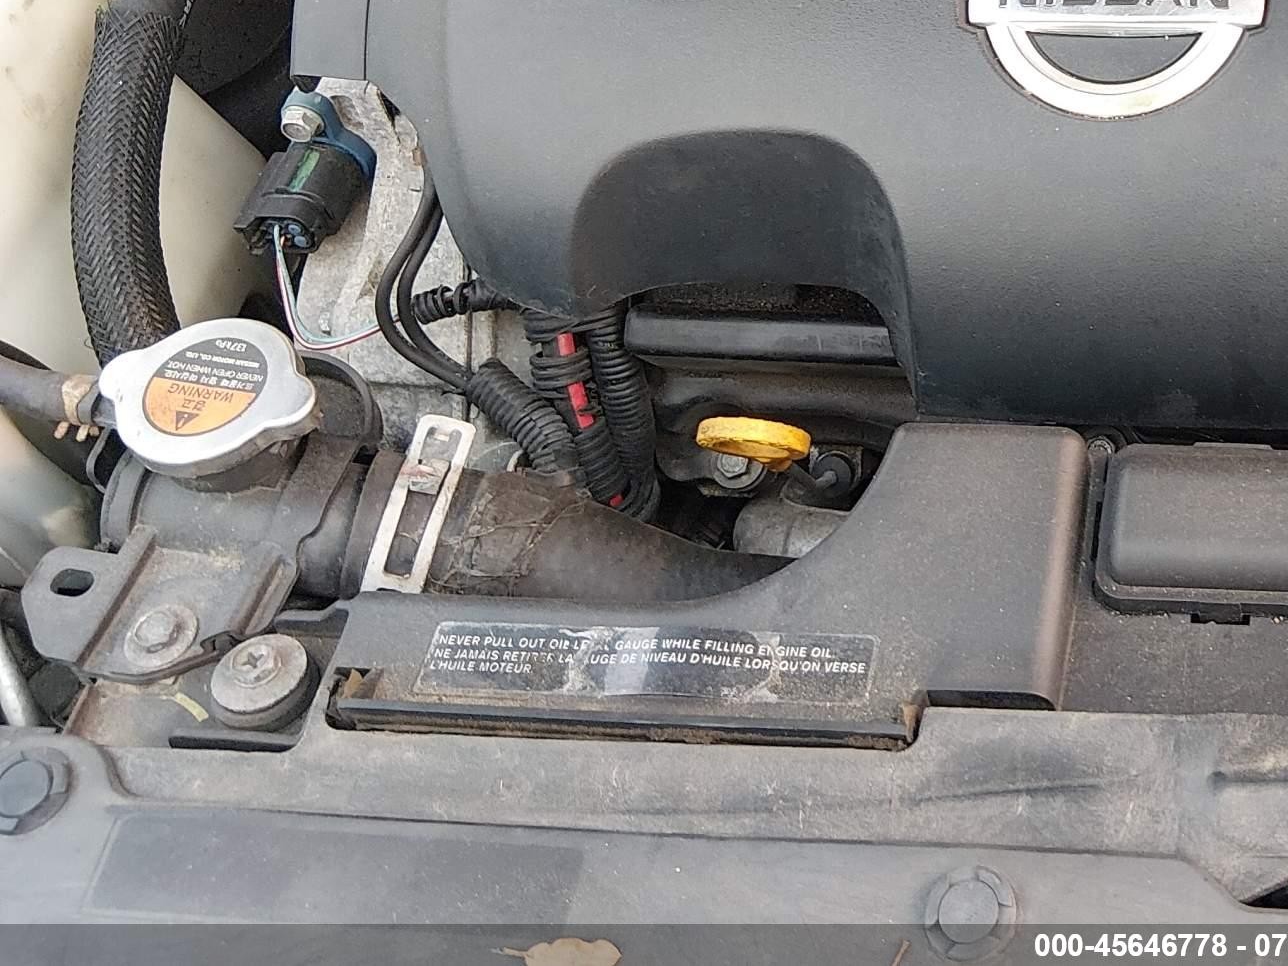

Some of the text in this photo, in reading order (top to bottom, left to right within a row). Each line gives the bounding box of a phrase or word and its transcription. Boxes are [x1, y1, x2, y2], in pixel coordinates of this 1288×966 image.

[167, 383, 234, 403] WARNING
[439, 635, 481, 647] NEVER
[484, 636, 514, 648] PULL
[518, 637, 546, 649] OUT
[615, 639, 659, 651] GAUGE
[662, 638, 702, 651] WHILE
[704, 639, 755, 655] FILLING
[430, 660, 476, 672] L'HUILE
[434, 648, 452, 659] NE
[454, 649, 500, 661] JAMAIS
[557, 653, 574, 664] LA
[620, 653, 637, 665] DE
[640, 652, 687, 664] NIVEAU
[690, 653, 742, 668] D'HUILE
[824, 662, 866, 674] VERSE
